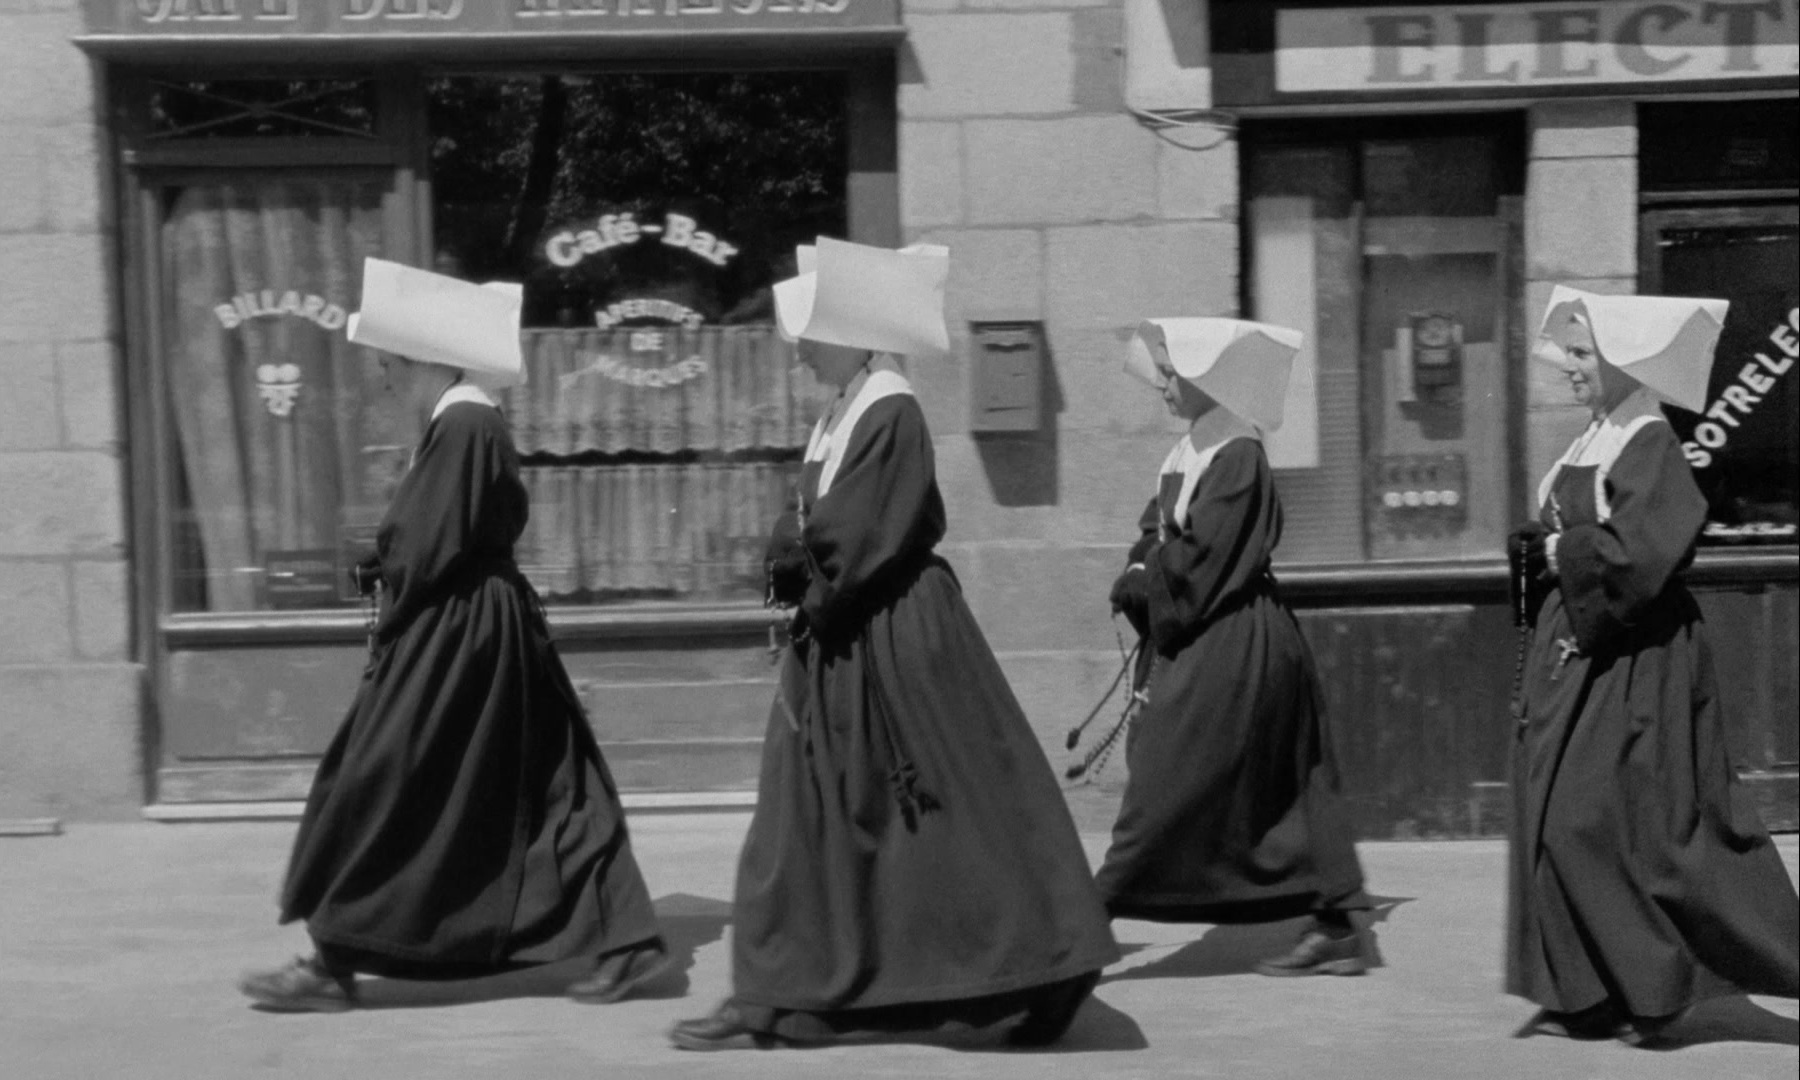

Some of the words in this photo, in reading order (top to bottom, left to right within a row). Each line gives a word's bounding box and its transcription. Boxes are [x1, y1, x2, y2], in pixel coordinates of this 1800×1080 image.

[1364, 3, 1798, 83] ELECT
[546, 212, 738, 267] Café-Bar
[214, 289, 346, 329] BILLARD
[630, 333, 662, 351] DE
